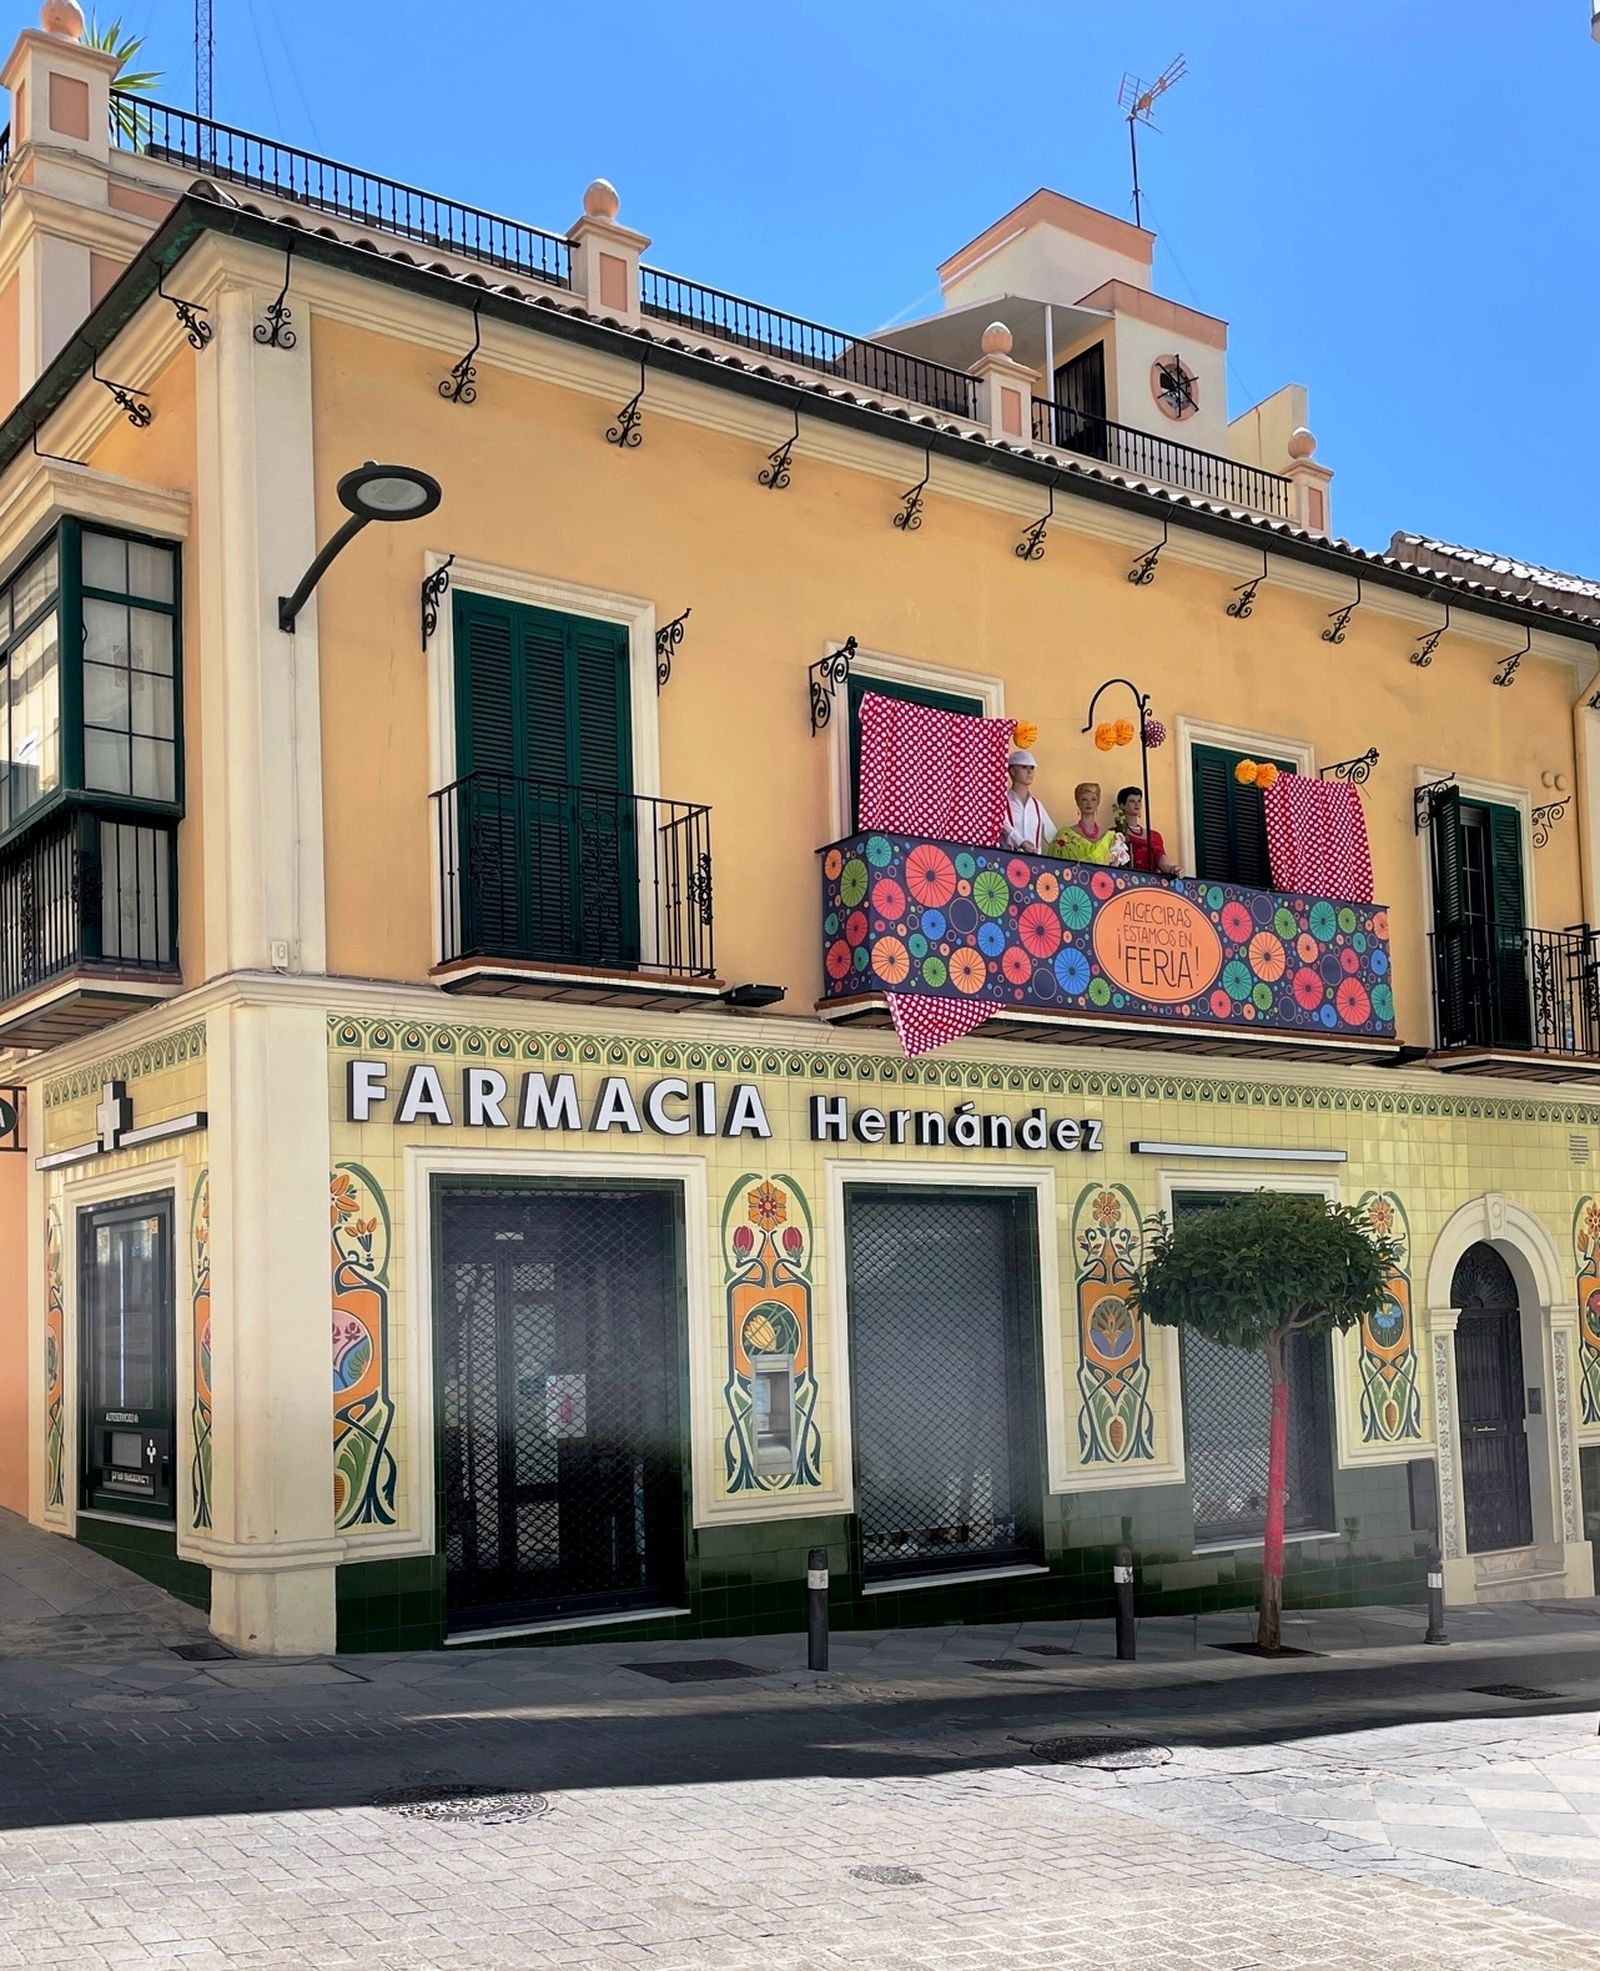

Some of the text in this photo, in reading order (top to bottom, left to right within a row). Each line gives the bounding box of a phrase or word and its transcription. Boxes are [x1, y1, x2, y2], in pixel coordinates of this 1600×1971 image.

[1179, 930, 1192, 949] EN
[346, 1060, 1103, 1151] FARMACIA Hernández
